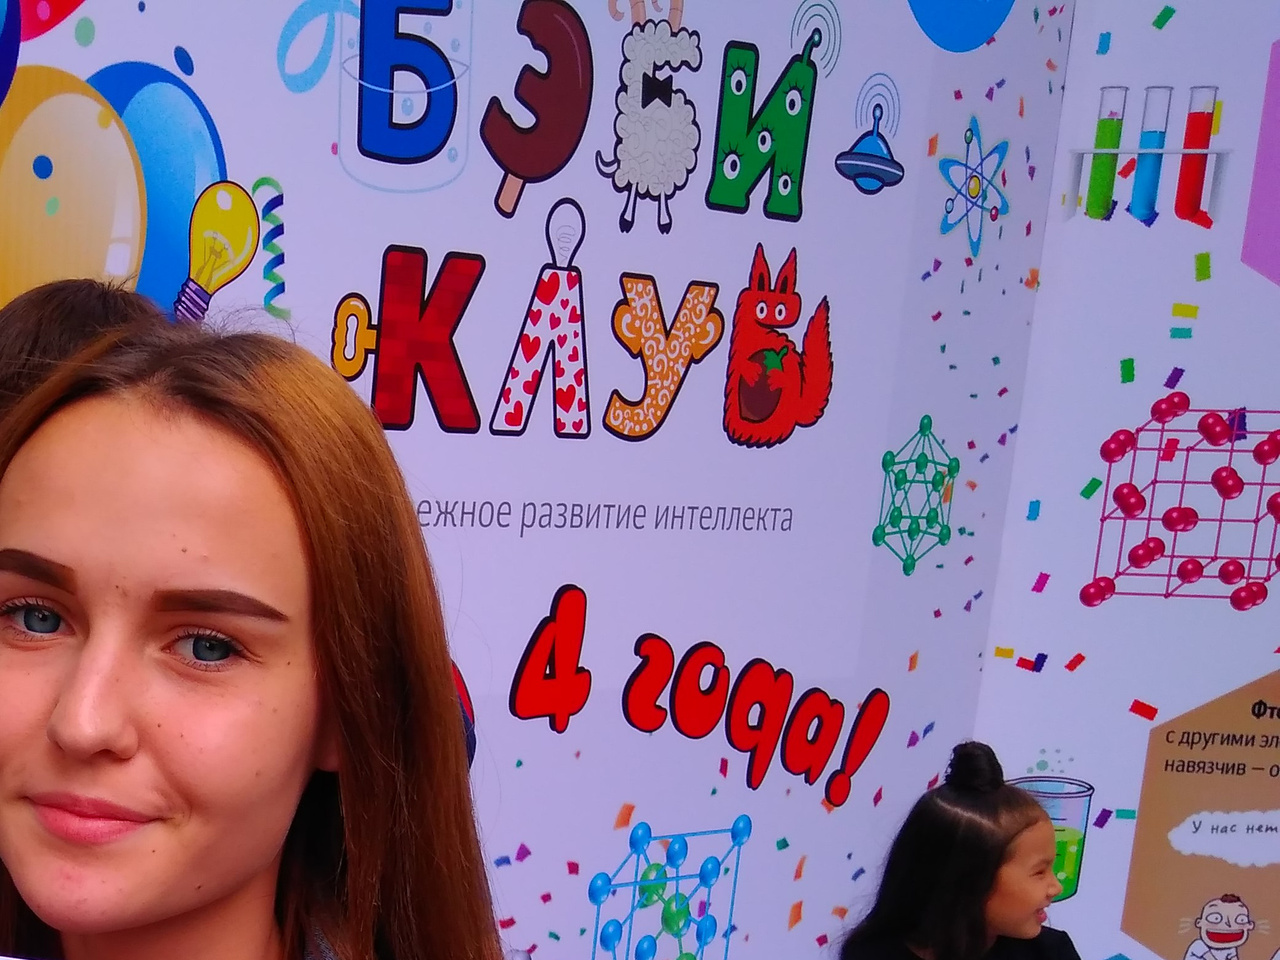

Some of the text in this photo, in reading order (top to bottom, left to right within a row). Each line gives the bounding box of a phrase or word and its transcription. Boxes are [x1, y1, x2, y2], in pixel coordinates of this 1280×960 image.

[357, 0, 818, 233] БЭБИ
[332, 199, 834, 449] КЛУБ
[417, 499, 793, 538] ежное развитие интеллекта
[509, 584, 891, 808] 4 года!
[1166, 730, 1280, 751] с другими эл
[1164, 759, 1246, 776] навязчив
[1192, 821, 1278, 834] У нас нет
